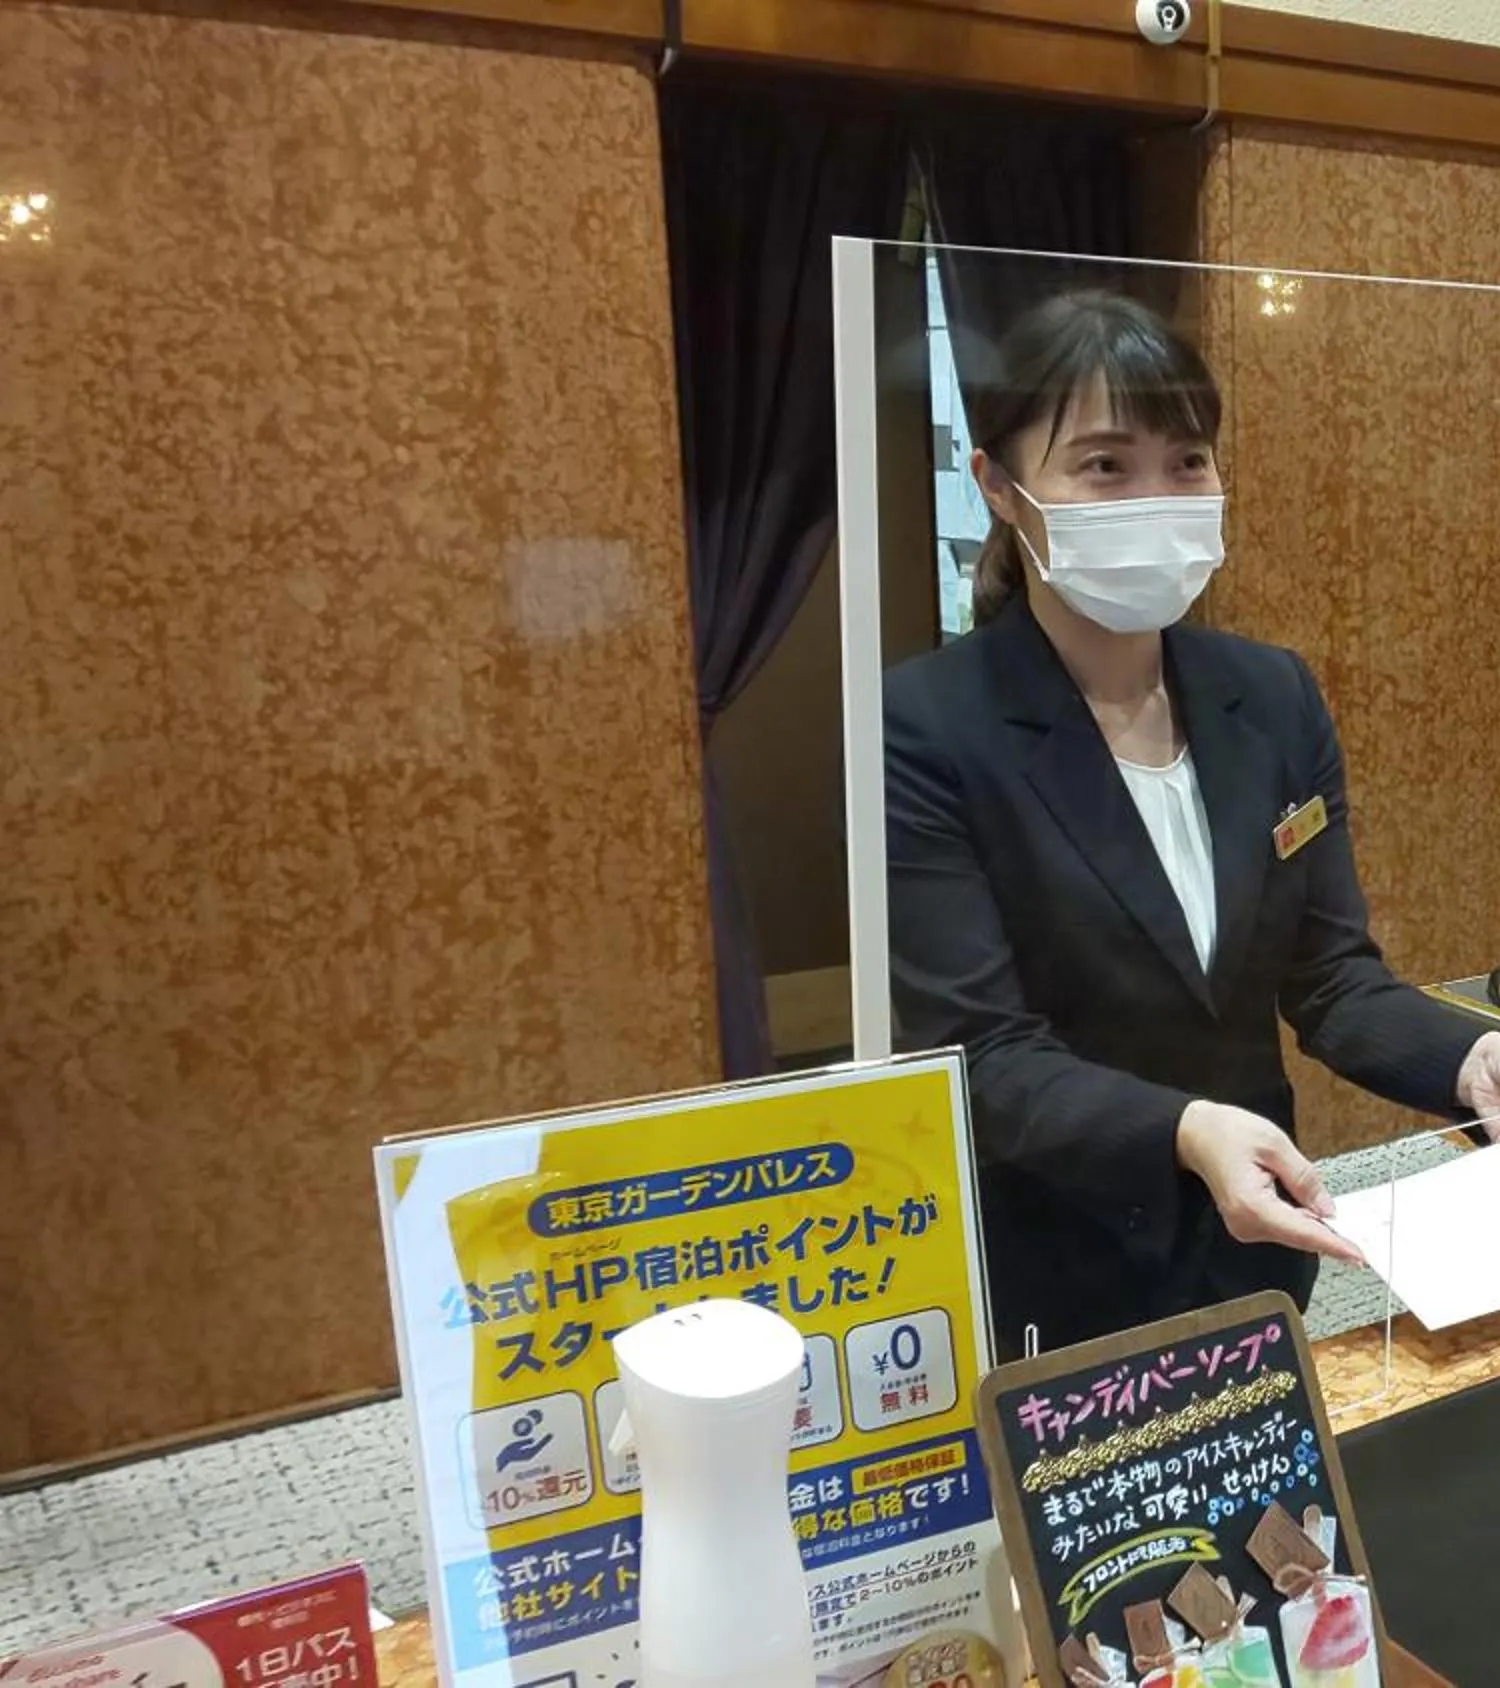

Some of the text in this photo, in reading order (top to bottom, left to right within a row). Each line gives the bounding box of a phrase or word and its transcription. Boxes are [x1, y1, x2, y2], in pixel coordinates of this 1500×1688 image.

[547, 1149, 837, 1228] 東京ガーデンパレス
[440, 1194, 939, 1328] 公式HP宿泊ポイントが
[1018, 1323, 1281, 1441] キャンディバーソープ
[1043, 1411, 1297, 1527] まるで本物のアイスキャンディー
[474, 1533, 642, 1598] 公式ホーム
[808, 1540, 976, 1598] ス公式ホームページからの
[236, 1626, 356, 1681] 1日パス
